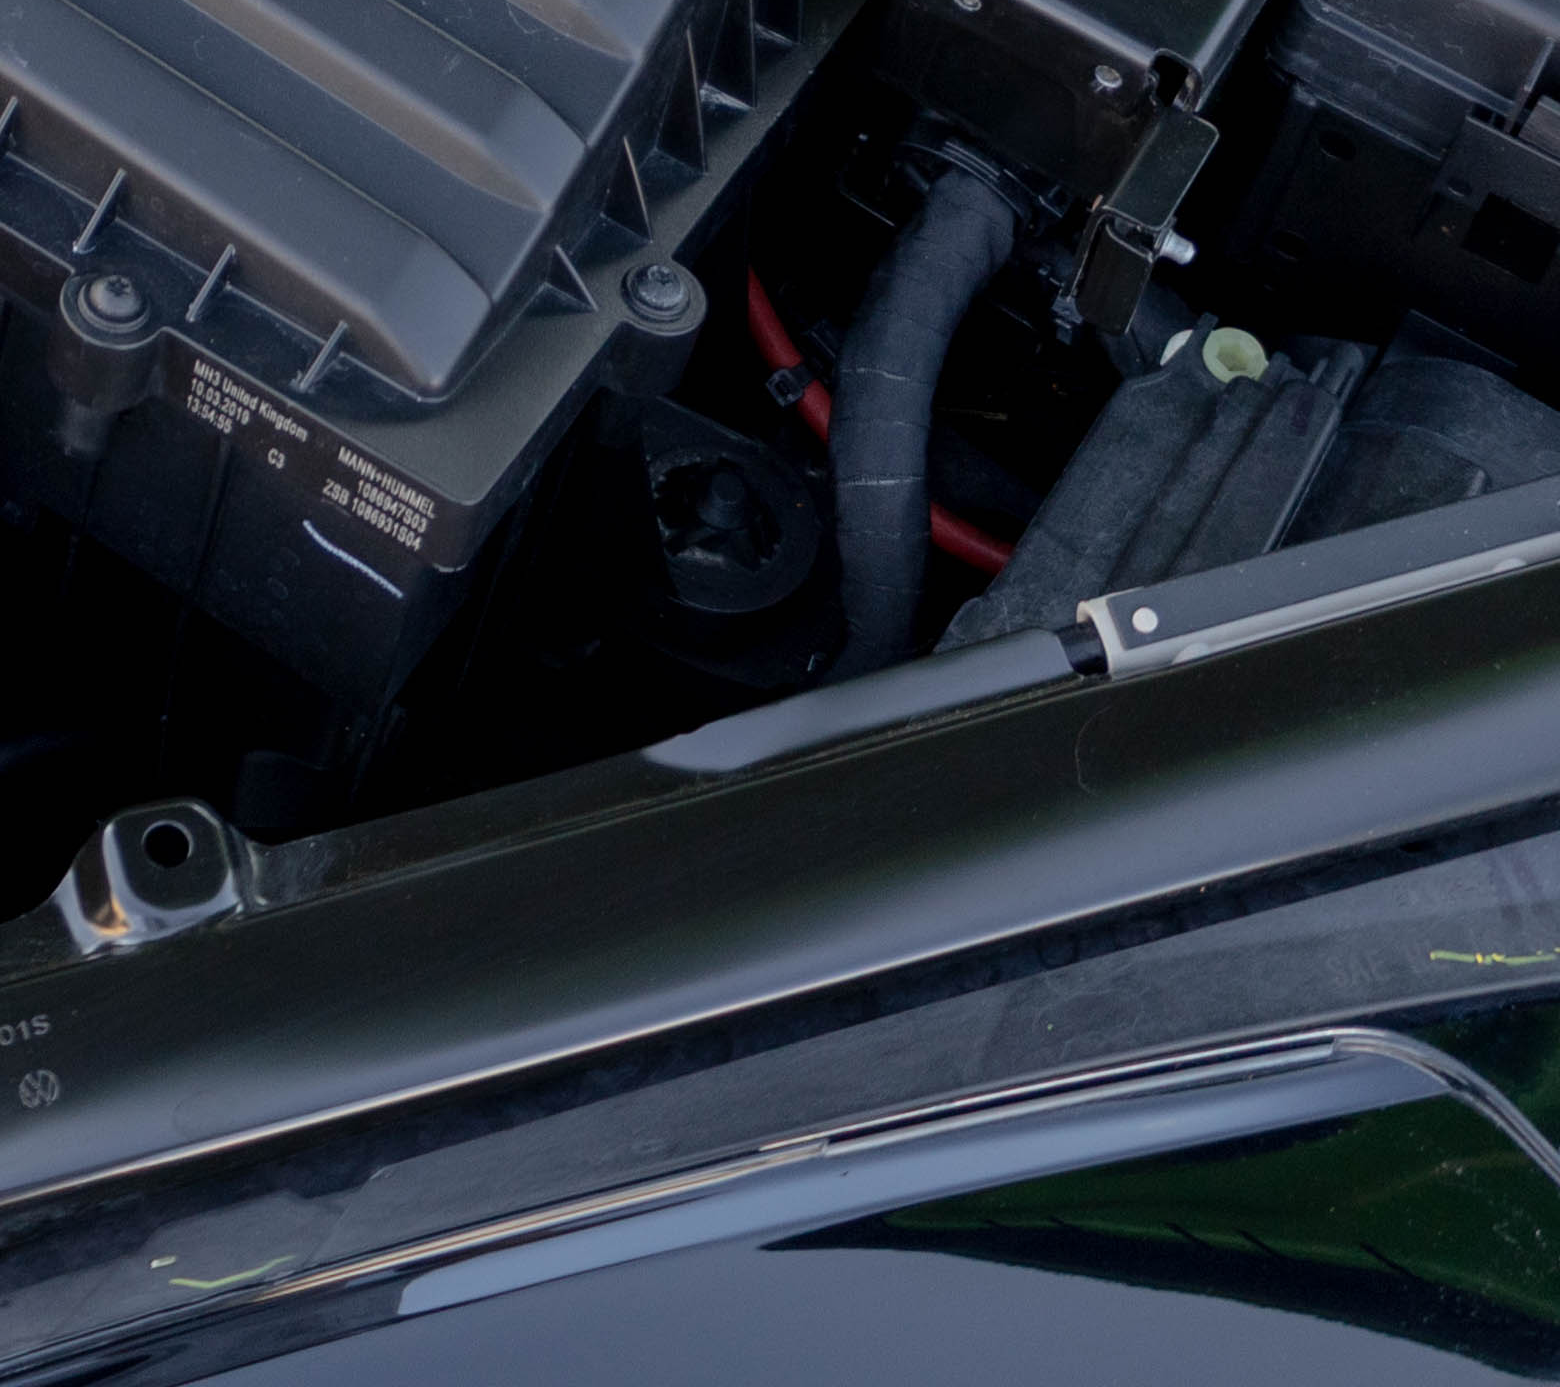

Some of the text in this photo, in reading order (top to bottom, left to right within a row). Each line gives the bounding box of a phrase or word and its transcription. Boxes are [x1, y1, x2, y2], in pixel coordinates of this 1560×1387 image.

[190, 377, 250, 425] 10.03.2019
[193, 358, 308, 443] MH3 United Kingdom
[321, 477, 350, 506] ZSB
[337, 446, 434, 518] MANN+HUMMEL
